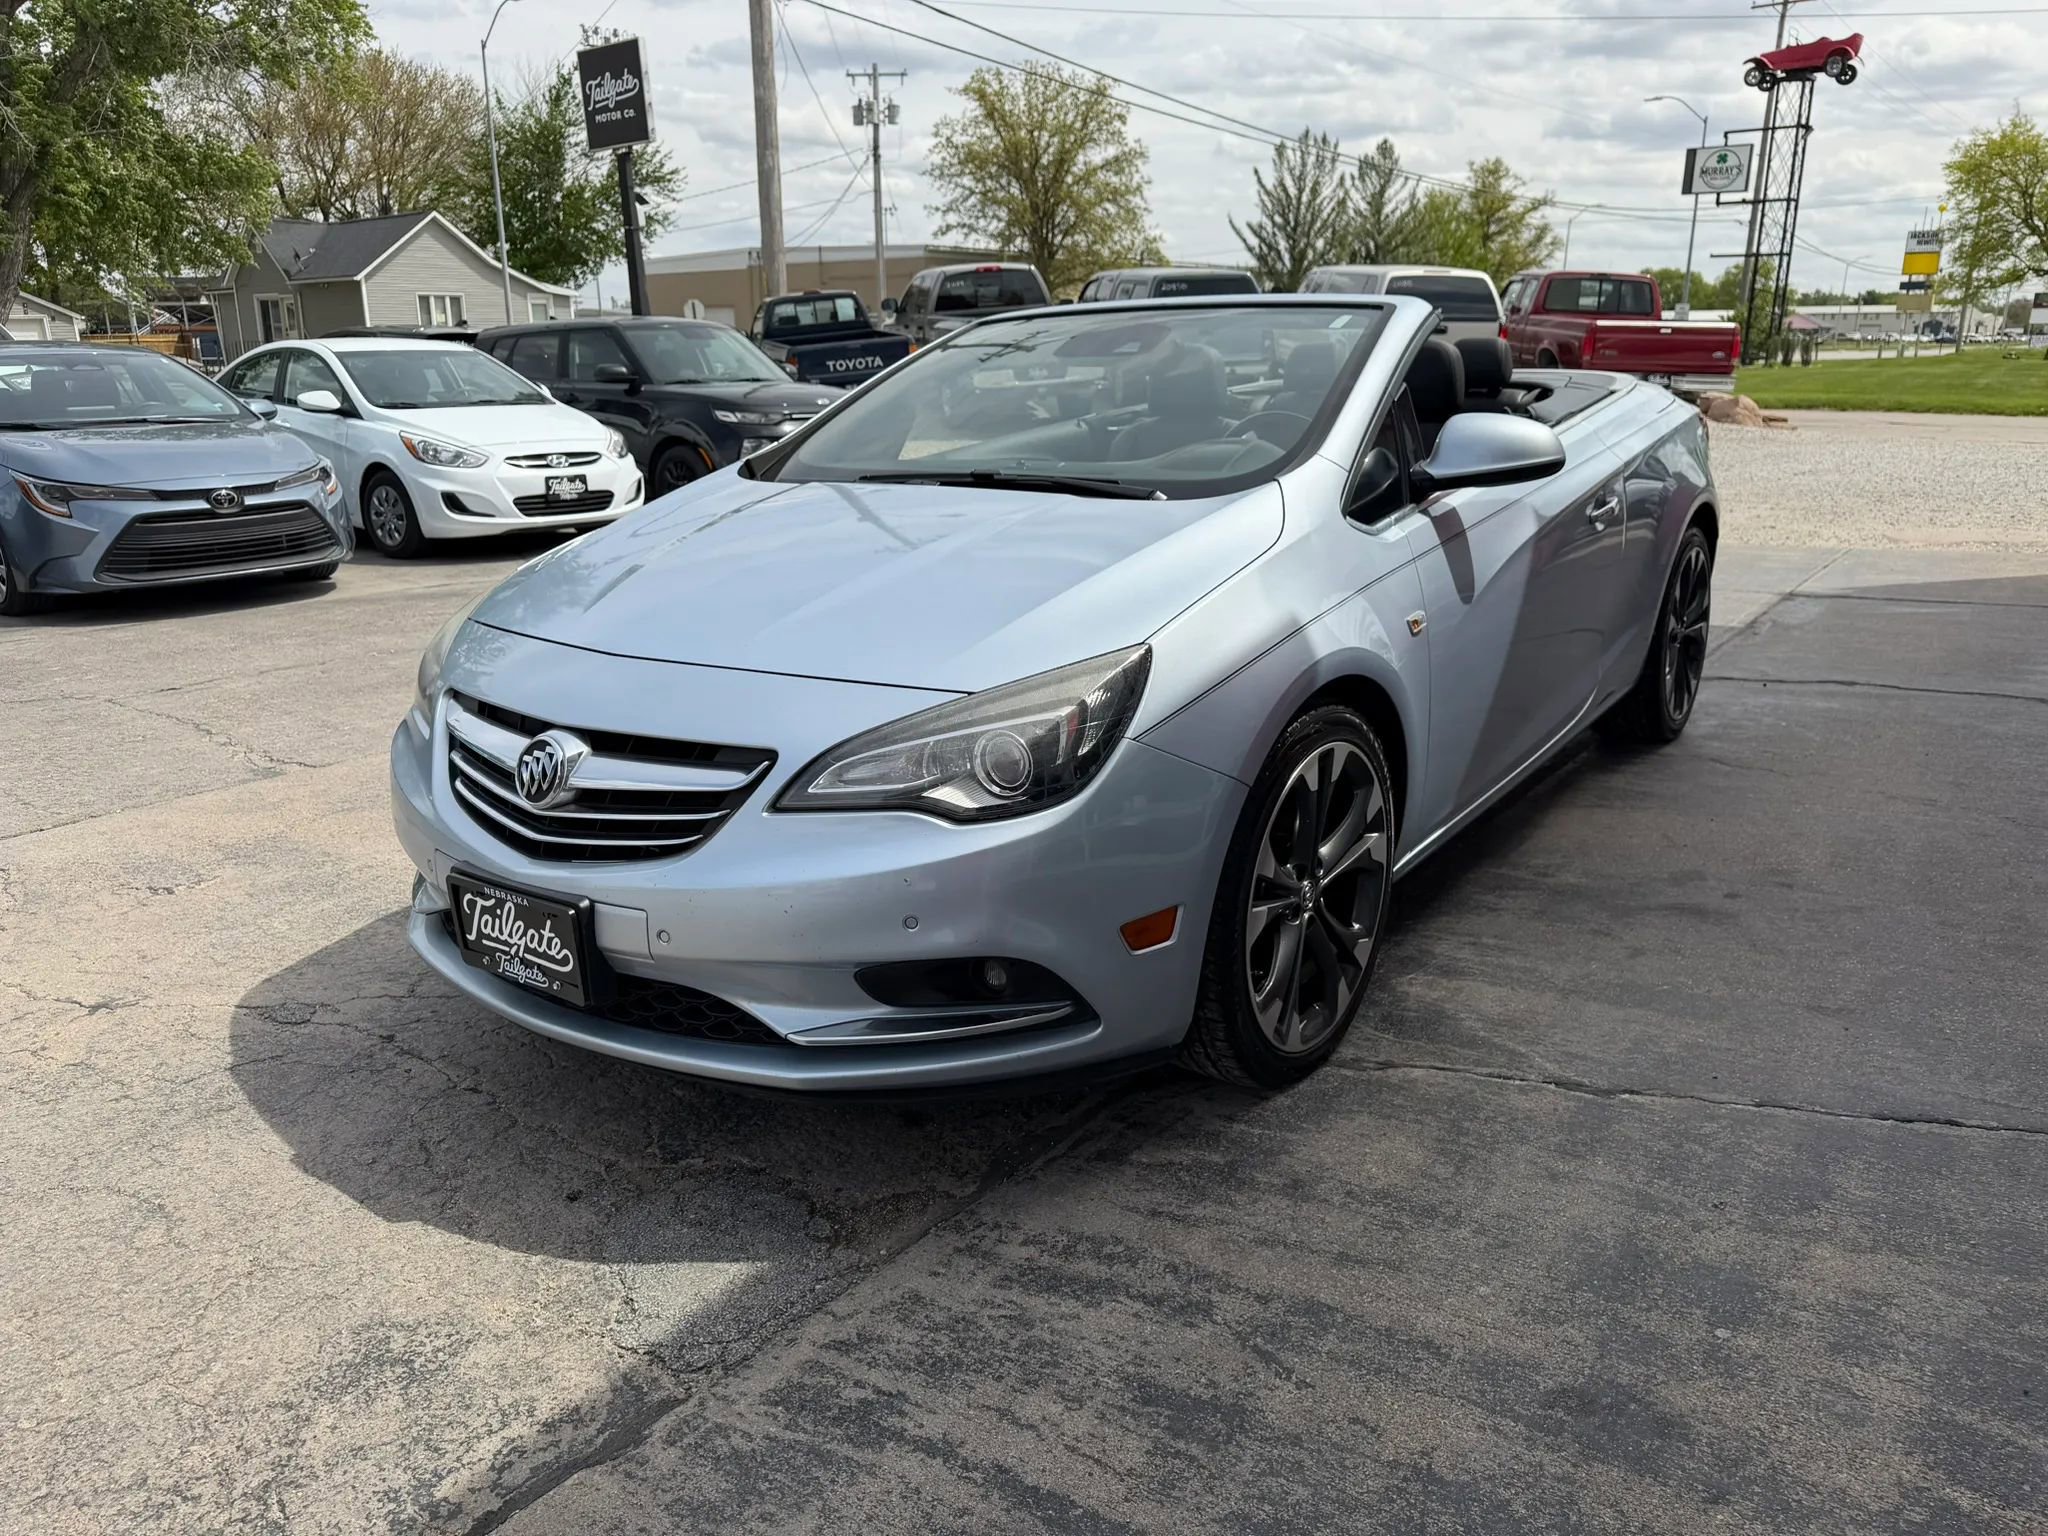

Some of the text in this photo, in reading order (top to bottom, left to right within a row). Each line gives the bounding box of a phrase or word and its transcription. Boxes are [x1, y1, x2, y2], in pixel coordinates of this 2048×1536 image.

[586, 67, 640, 111] Tailgate
[595, 109, 637, 123] MOTOR CO.
[826, 356, 884, 372] TOYOTA
[484, 886, 529, 907] NEBRASKA
[463, 893, 574, 972] Tailgate
[496, 952, 549, 987] Tailgate
